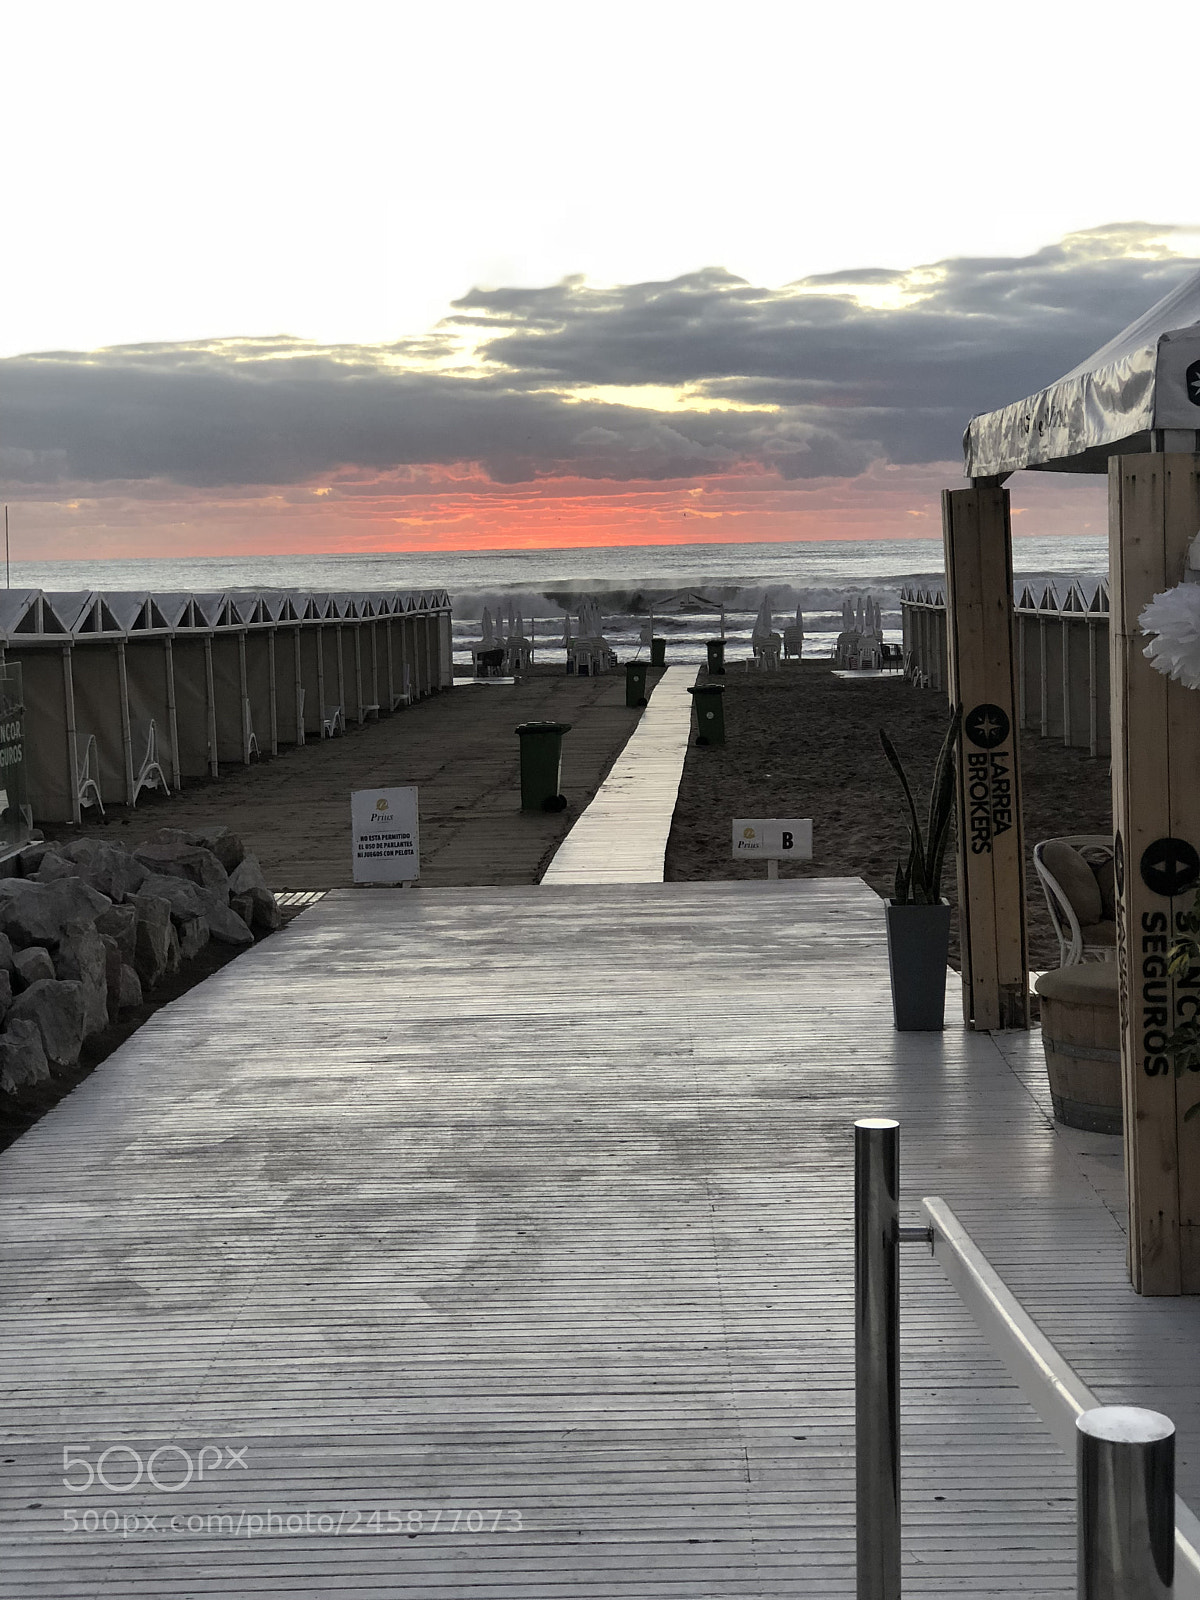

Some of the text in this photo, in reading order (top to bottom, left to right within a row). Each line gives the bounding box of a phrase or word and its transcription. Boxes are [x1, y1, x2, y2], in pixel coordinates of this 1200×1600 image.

[990, 751, 1013, 836] LARREA
[968, 753, 991, 855] BROKERS
[370, 812, 394, 822] Prius
[381, 833, 411, 841] PERMITIDO
[782, 831, 794, 850] B
[383, 841, 413, 849] PARLANTES
[737, 840, 759, 849] Prius
[364, 850, 383, 858] JUEGOS
[1141, 911, 1169, 1077] SEGUROS
